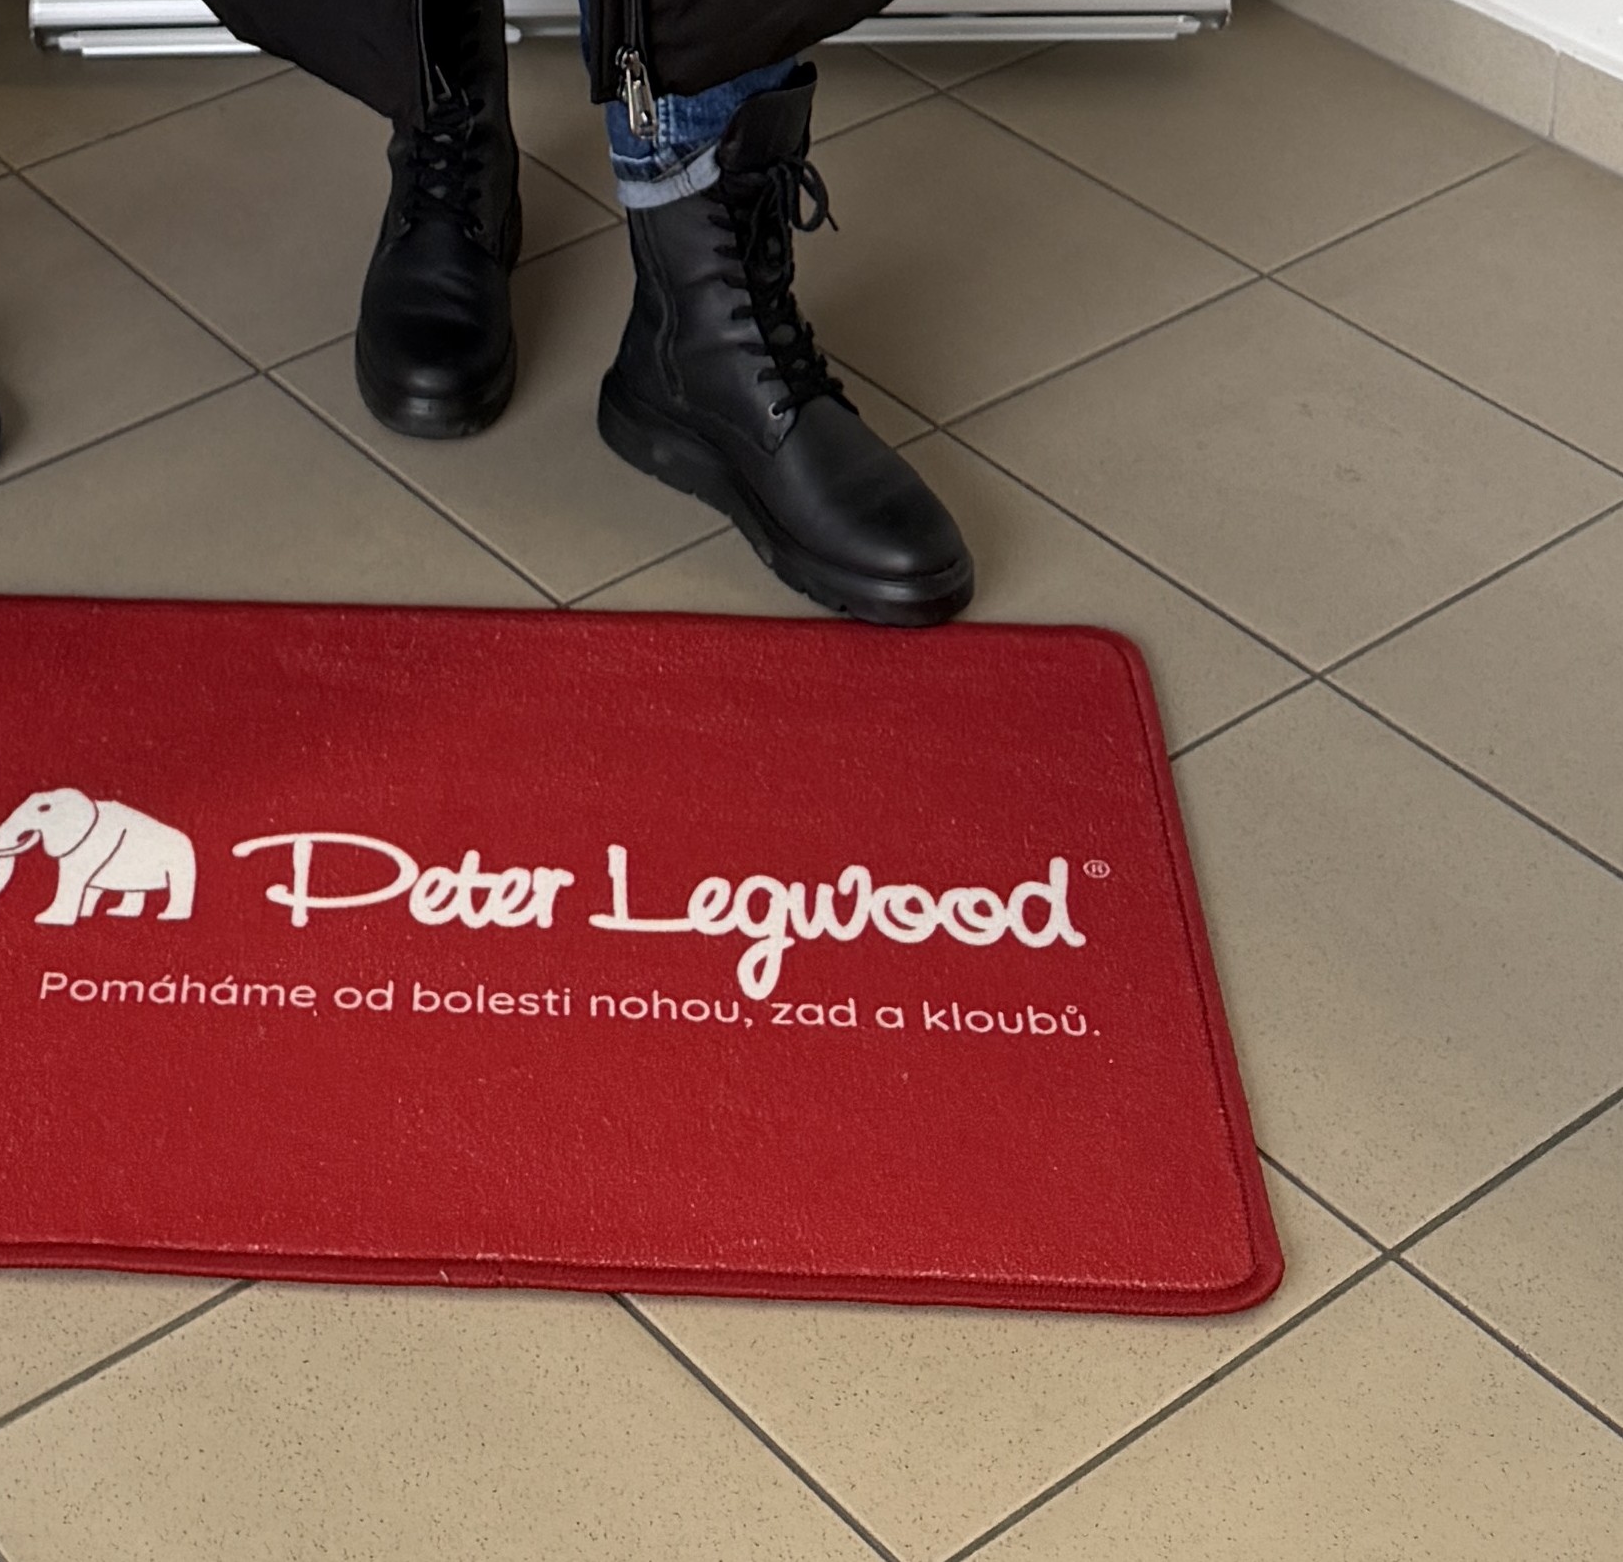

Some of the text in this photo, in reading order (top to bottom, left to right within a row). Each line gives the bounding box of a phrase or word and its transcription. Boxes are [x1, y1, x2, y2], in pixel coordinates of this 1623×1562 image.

[232, 832, 575, 929] Peter
[39, 971, 1103, 1038] Pomáháme od bolesti nohou, zad a kloubů.
